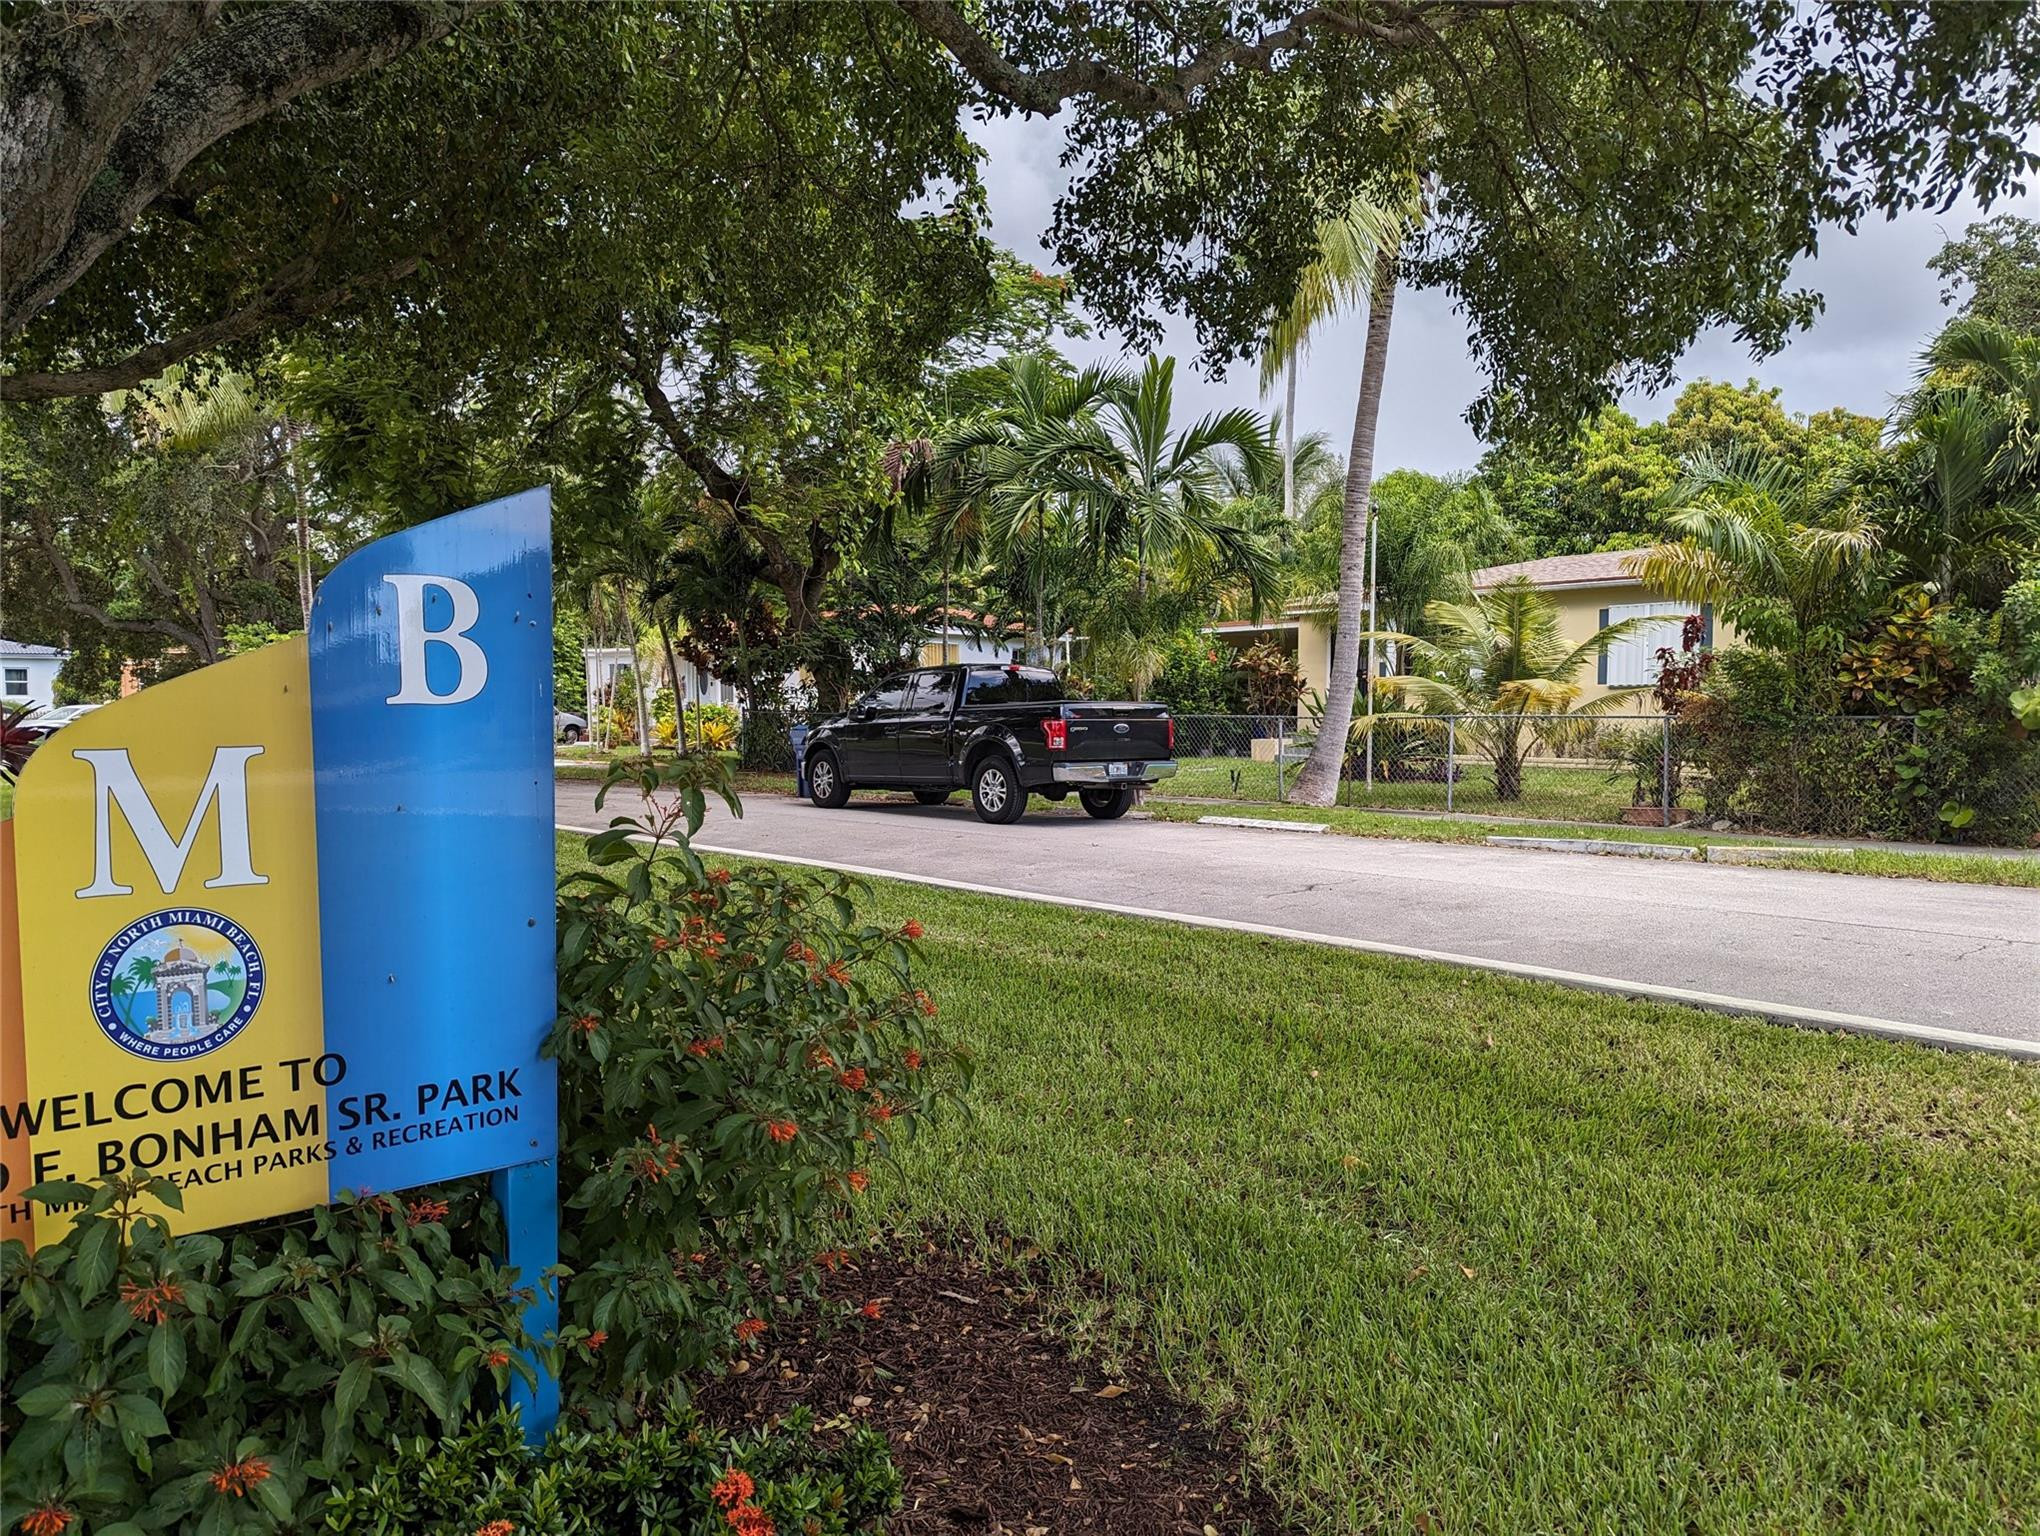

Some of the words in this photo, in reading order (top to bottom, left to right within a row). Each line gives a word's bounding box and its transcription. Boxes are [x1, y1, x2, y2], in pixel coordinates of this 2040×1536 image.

[382, 572, 490, 706] B
[71, 744, 270, 900] M
[108, 916, 163, 957] NORTH
[169, 911, 225, 931] MIAMI
[102, 960, 115, 977] OF
[95, 980, 112, 1018] CITY
[246, 982, 260, 1000] FL
[119, 1031, 159, 1056] WHERE
[164, 1039, 213, 1056] PEOPLE
[215, 1017, 244, 1042] CARE
[0, 1065, 265, 1140] WELCOME
[279, 1053, 347, 1092] TO
[97, 1104, 320, 1177] BONHAM
[338, 1092, 401, 1131] SR.
[417, 1067, 522, 1116] PARK
[155, 1159, 242, 1191] EACH
[254, 1140, 337, 1175] PARKS
[345, 1136, 363, 1156] &
[372, 1104, 519, 1150] RECREATION
